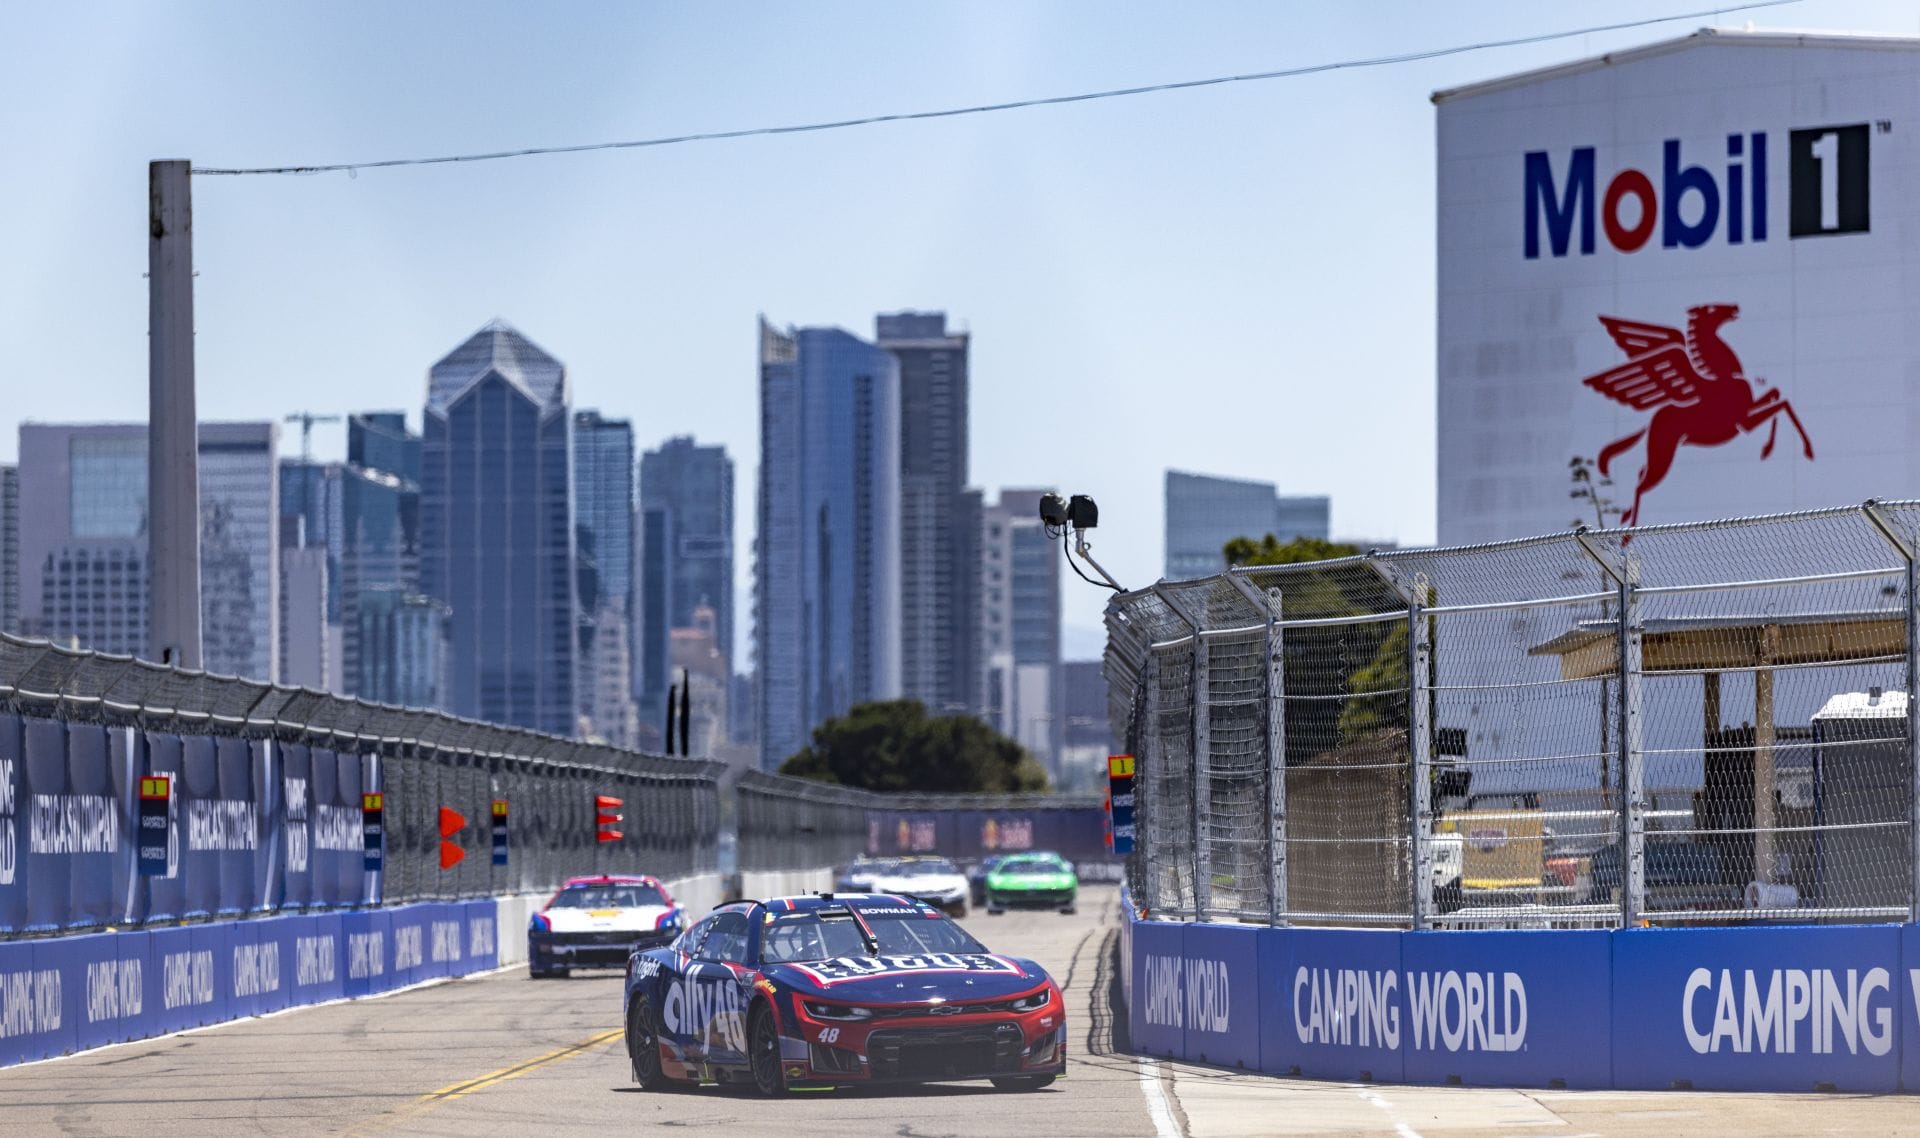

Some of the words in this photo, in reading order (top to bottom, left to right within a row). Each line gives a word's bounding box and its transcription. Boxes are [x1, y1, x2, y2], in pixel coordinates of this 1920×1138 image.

[1523, 131, 1767, 260] Mobil
[1811, 132, 1840, 231] 1
[152, 780, 158, 795] 1
[858, 907, 918, 915] BOWMAN
[34, 969, 62, 1033] WORLD
[663, 964, 713, 1056] ally
[714, 978, 746, 1053] 48
[1144, 953, 1183, 1029] CAMPING
[1185, 958, 1230, 1033] WORLD
[1293, 966, 1400, 1051] CAMPING
[1406, 970, 1528, 1052] WORLD
[1682, 966, 1893, 1057] CAMPING
[818, 1027, 840, 1043] 48
